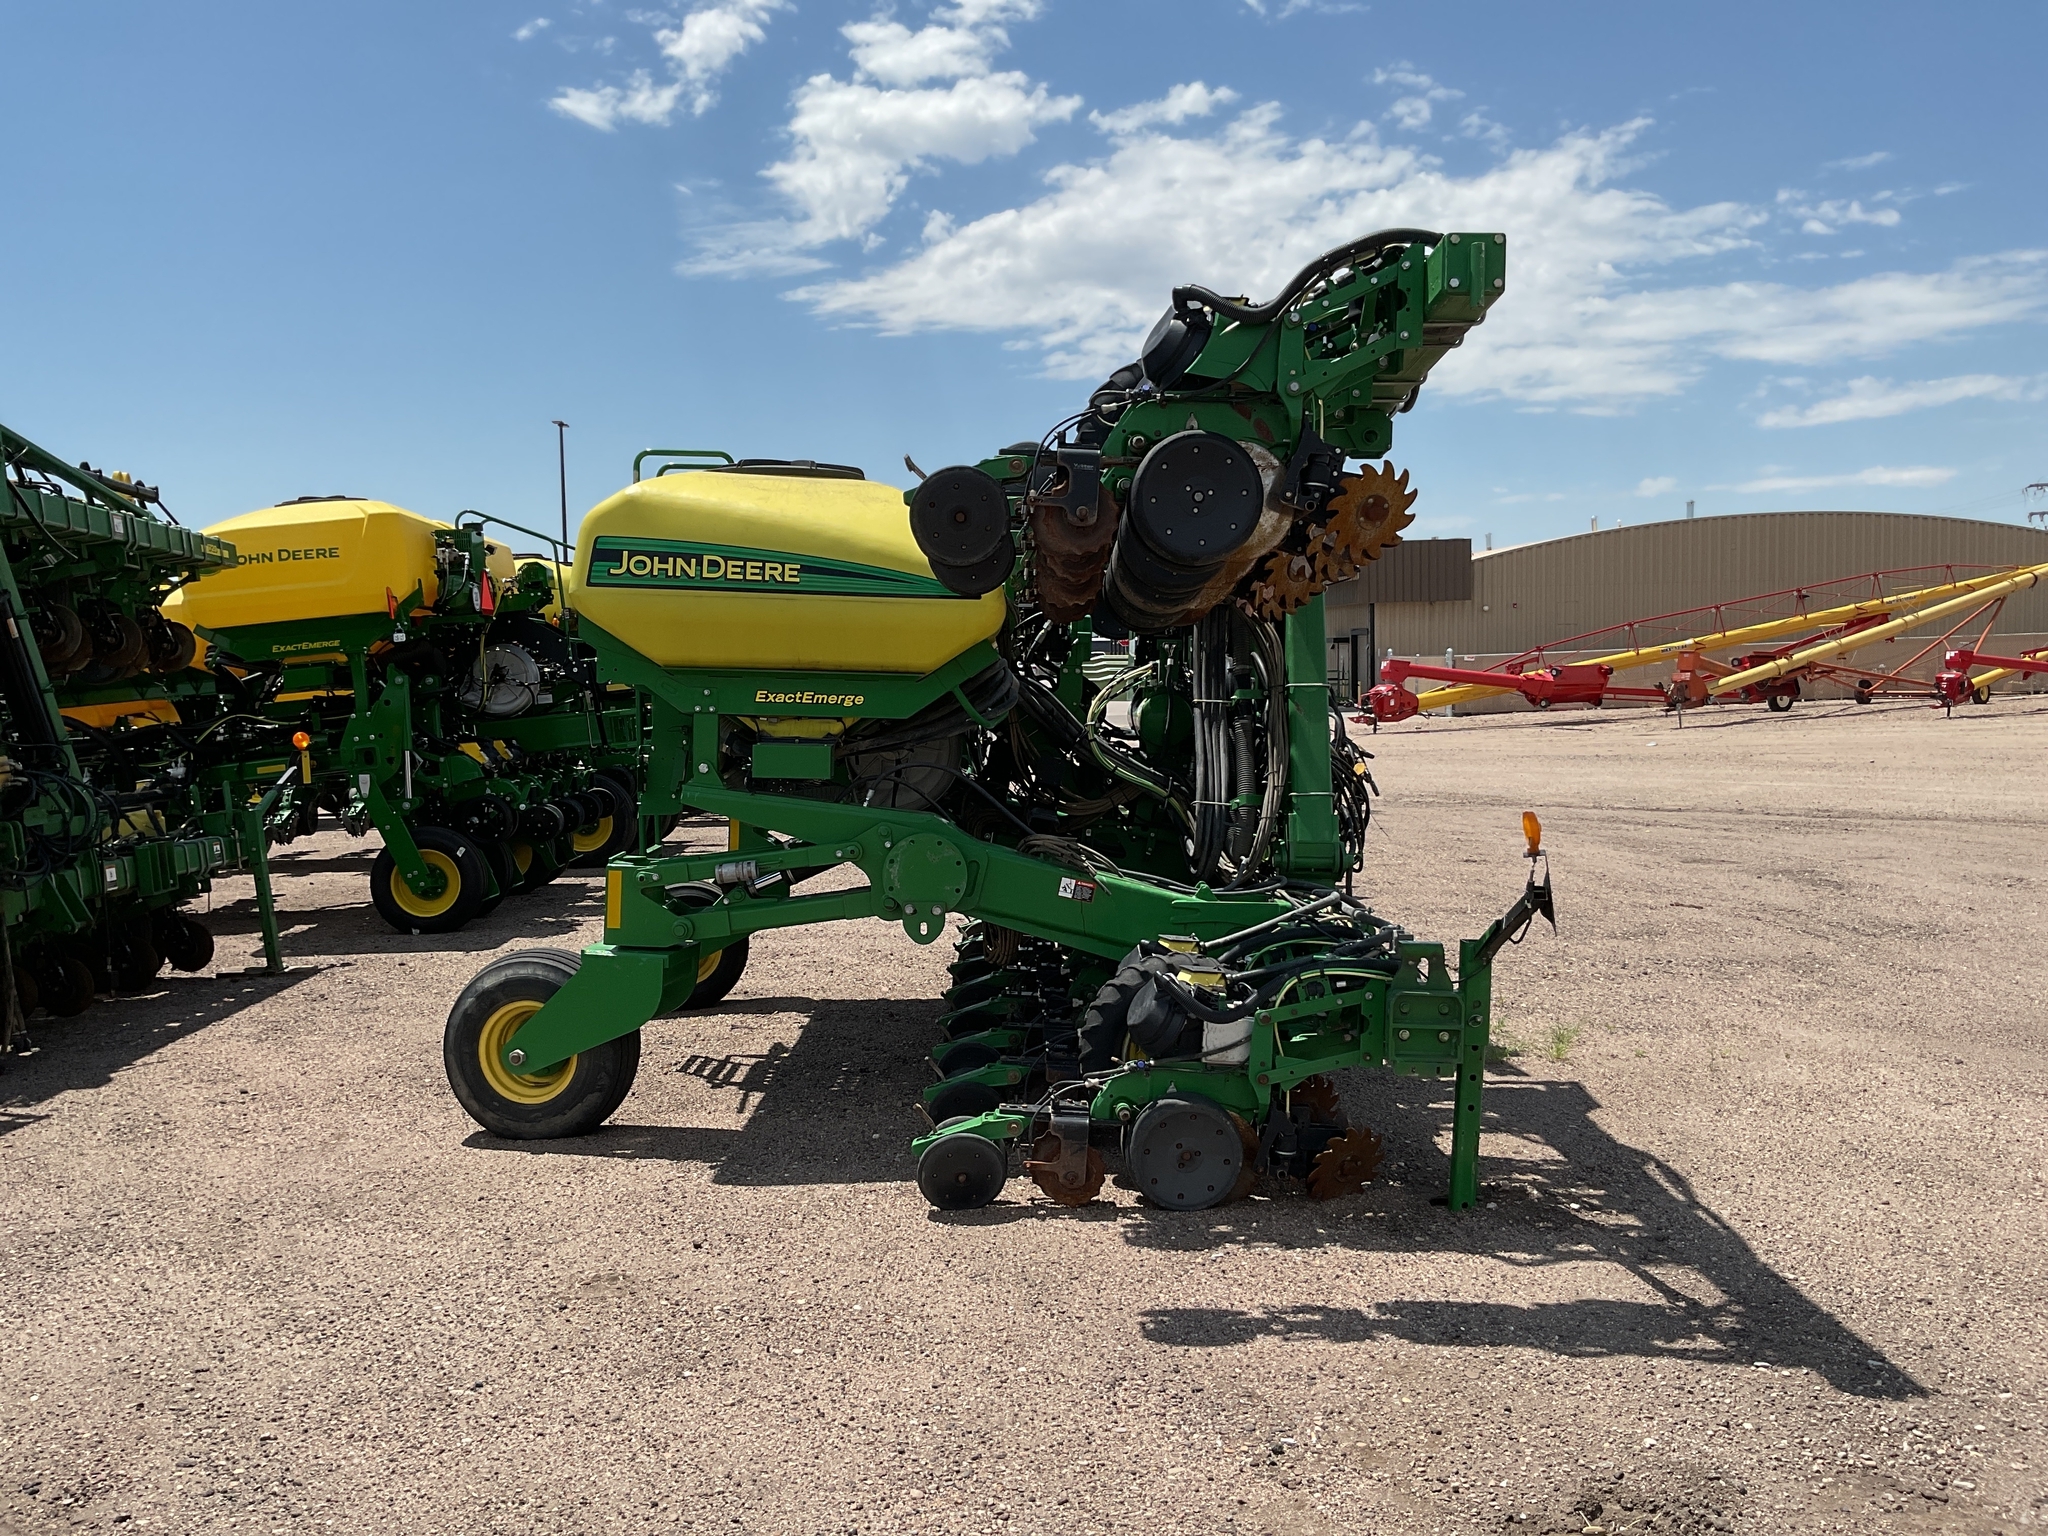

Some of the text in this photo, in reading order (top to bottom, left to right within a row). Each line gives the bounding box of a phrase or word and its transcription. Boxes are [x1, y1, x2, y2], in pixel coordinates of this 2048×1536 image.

[236, 547, 340, 565] OHN DEERE
[608, 550, 801, 583] JOHN DEERE
[755, 690, 865, 707] ExactEmerge
